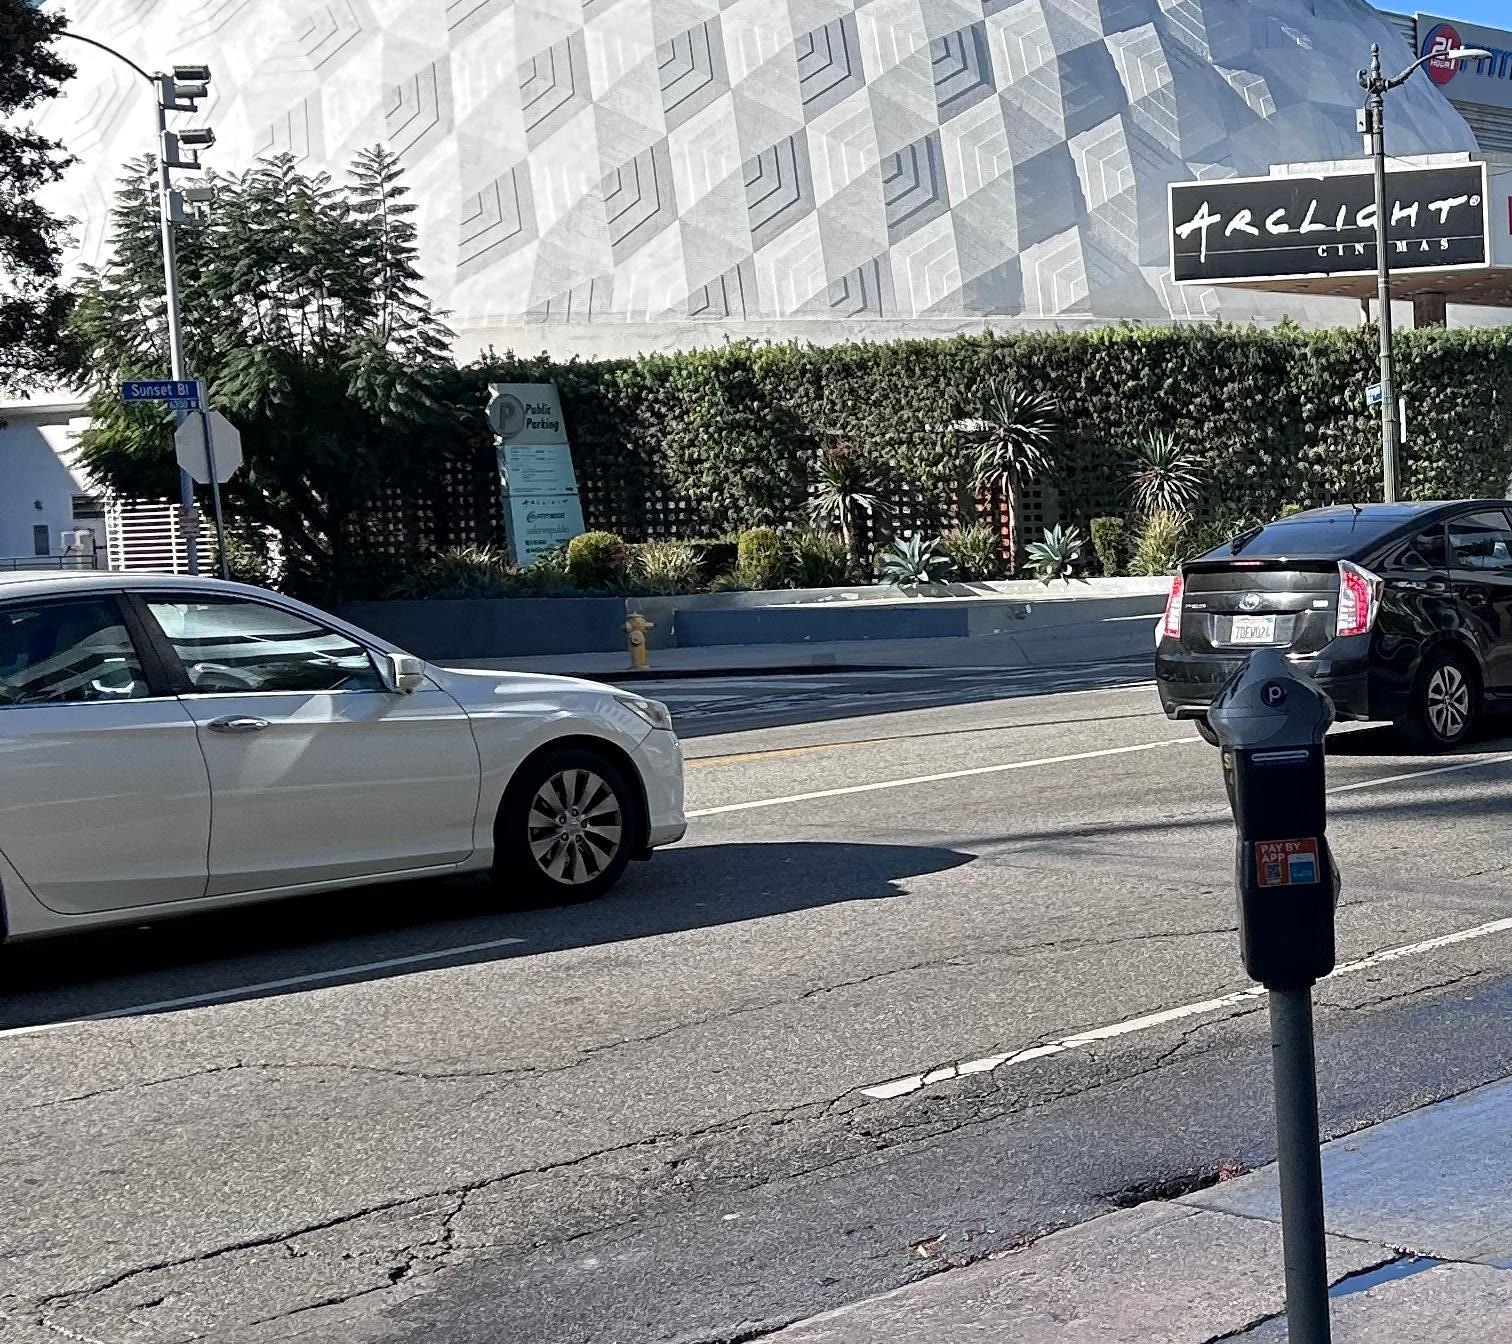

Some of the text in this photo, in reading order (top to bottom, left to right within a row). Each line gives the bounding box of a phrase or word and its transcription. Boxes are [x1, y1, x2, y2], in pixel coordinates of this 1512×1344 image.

[1318, 237, 1449, 257] CINMAS
[131, 383, 189, 397] Sunset Bl
[525, 402, 552, 415] Public
[526, 417, 560, 433] Parking
[1261, 841, 1301, 854] PAY BY
[1262, 853, 1285, 864] APP
